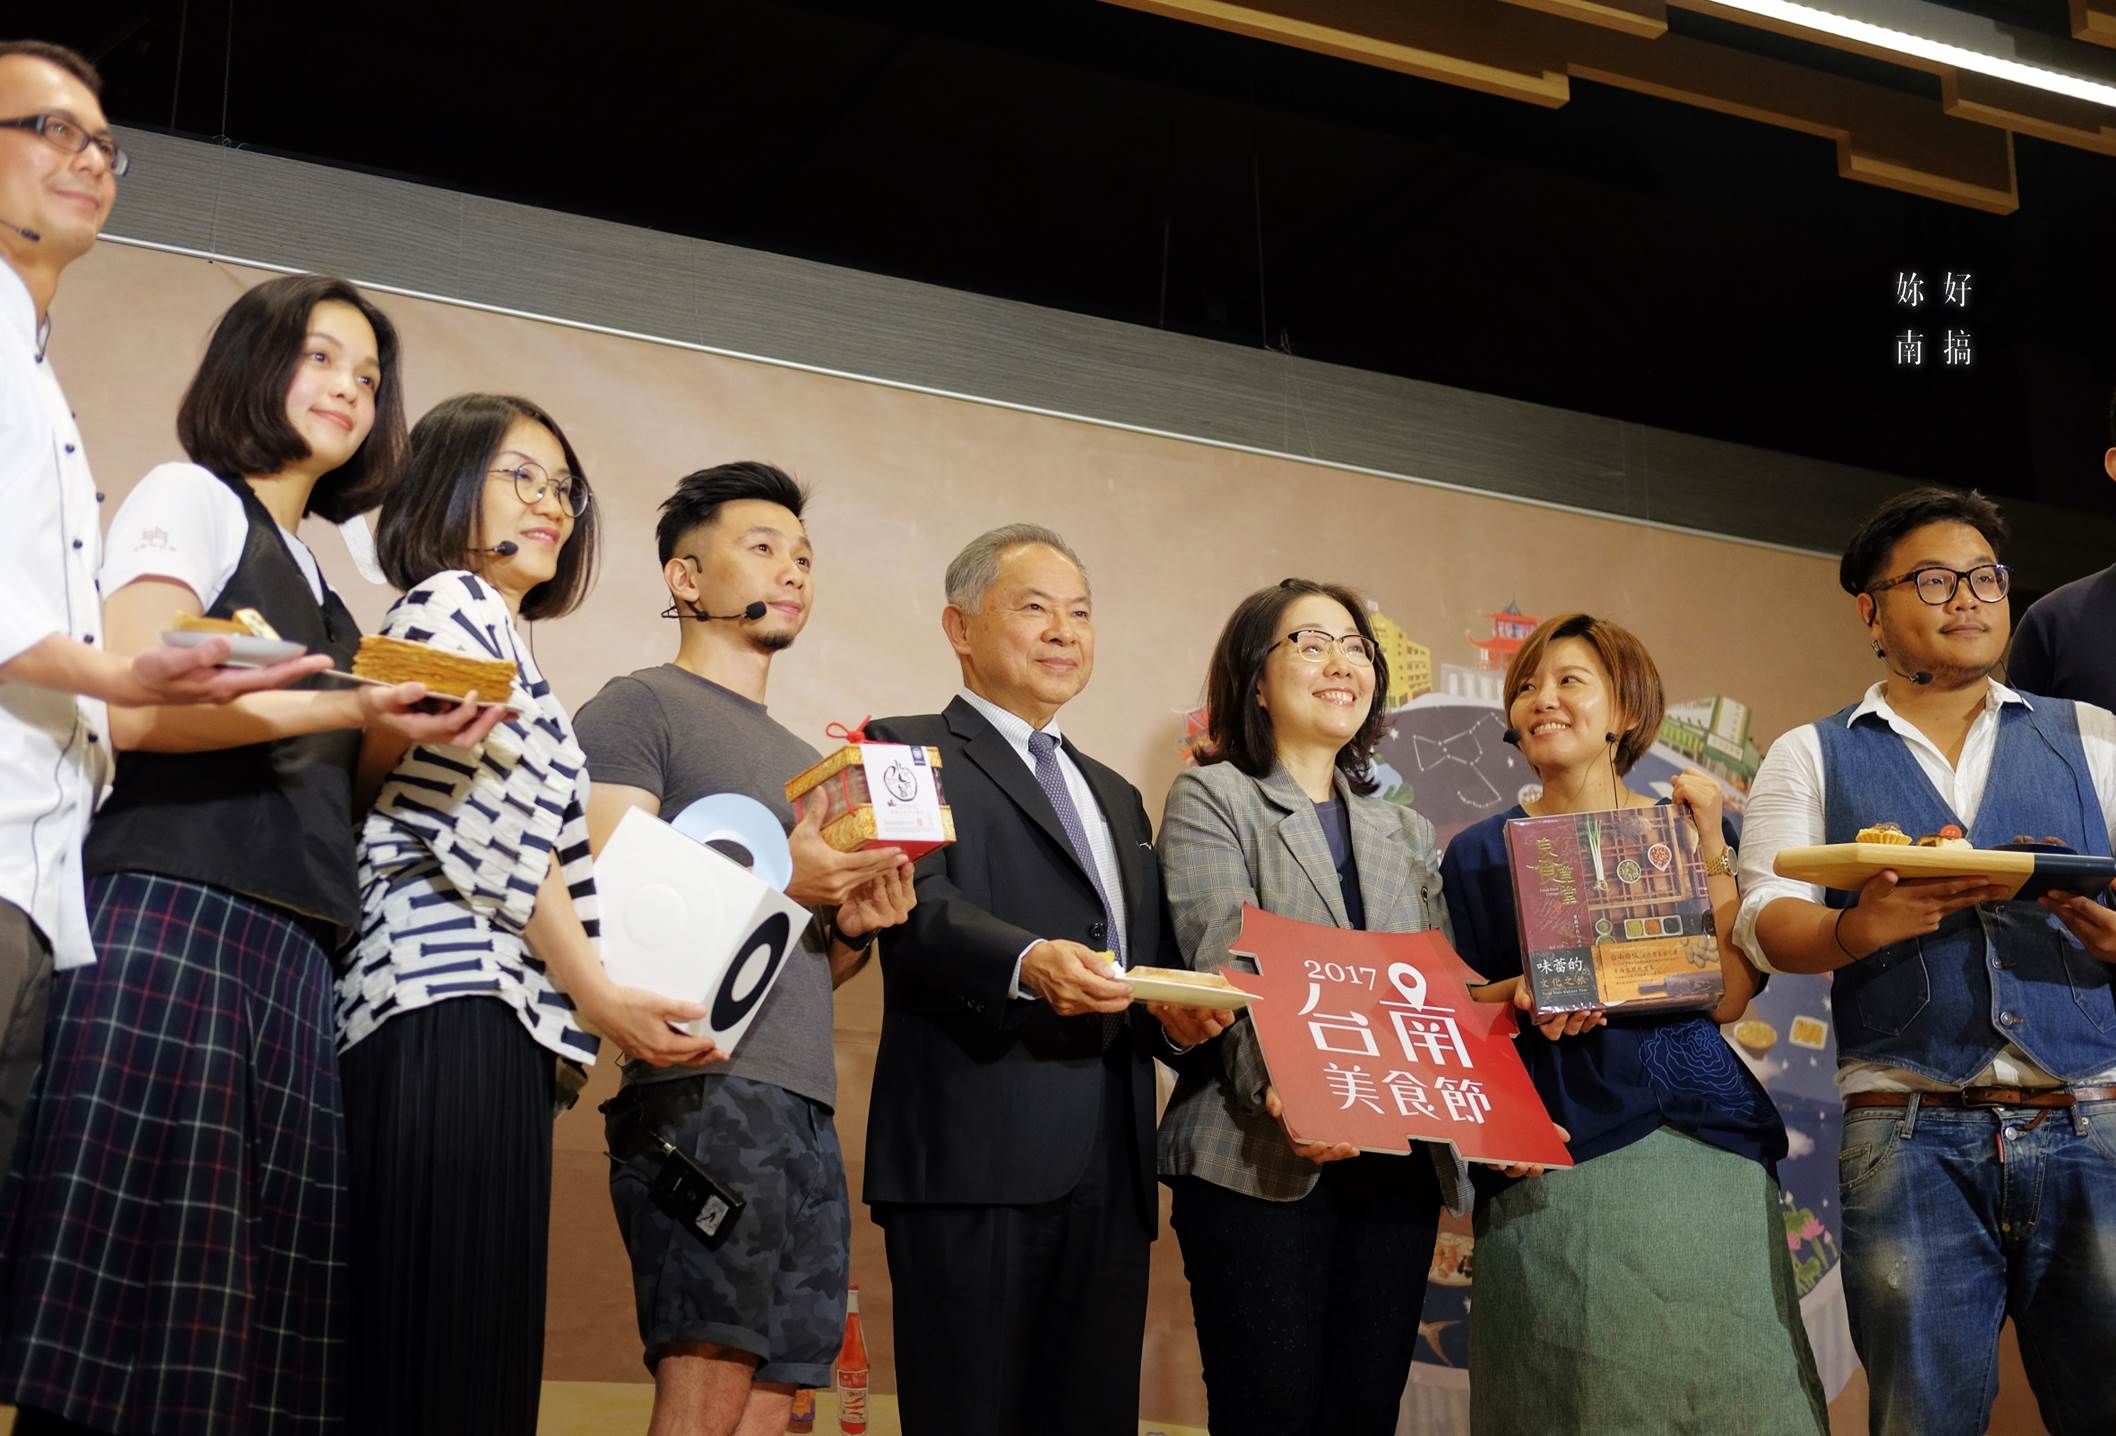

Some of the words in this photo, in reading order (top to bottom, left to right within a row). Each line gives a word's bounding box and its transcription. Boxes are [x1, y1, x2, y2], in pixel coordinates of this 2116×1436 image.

[1304, 960, 1376, 991] 2017
[1536, 956, 1583, 975] 味蕾的
[1298, 962, 1473, 1068] 台南
[1323, 1062, 1492, 1125] 美食節
